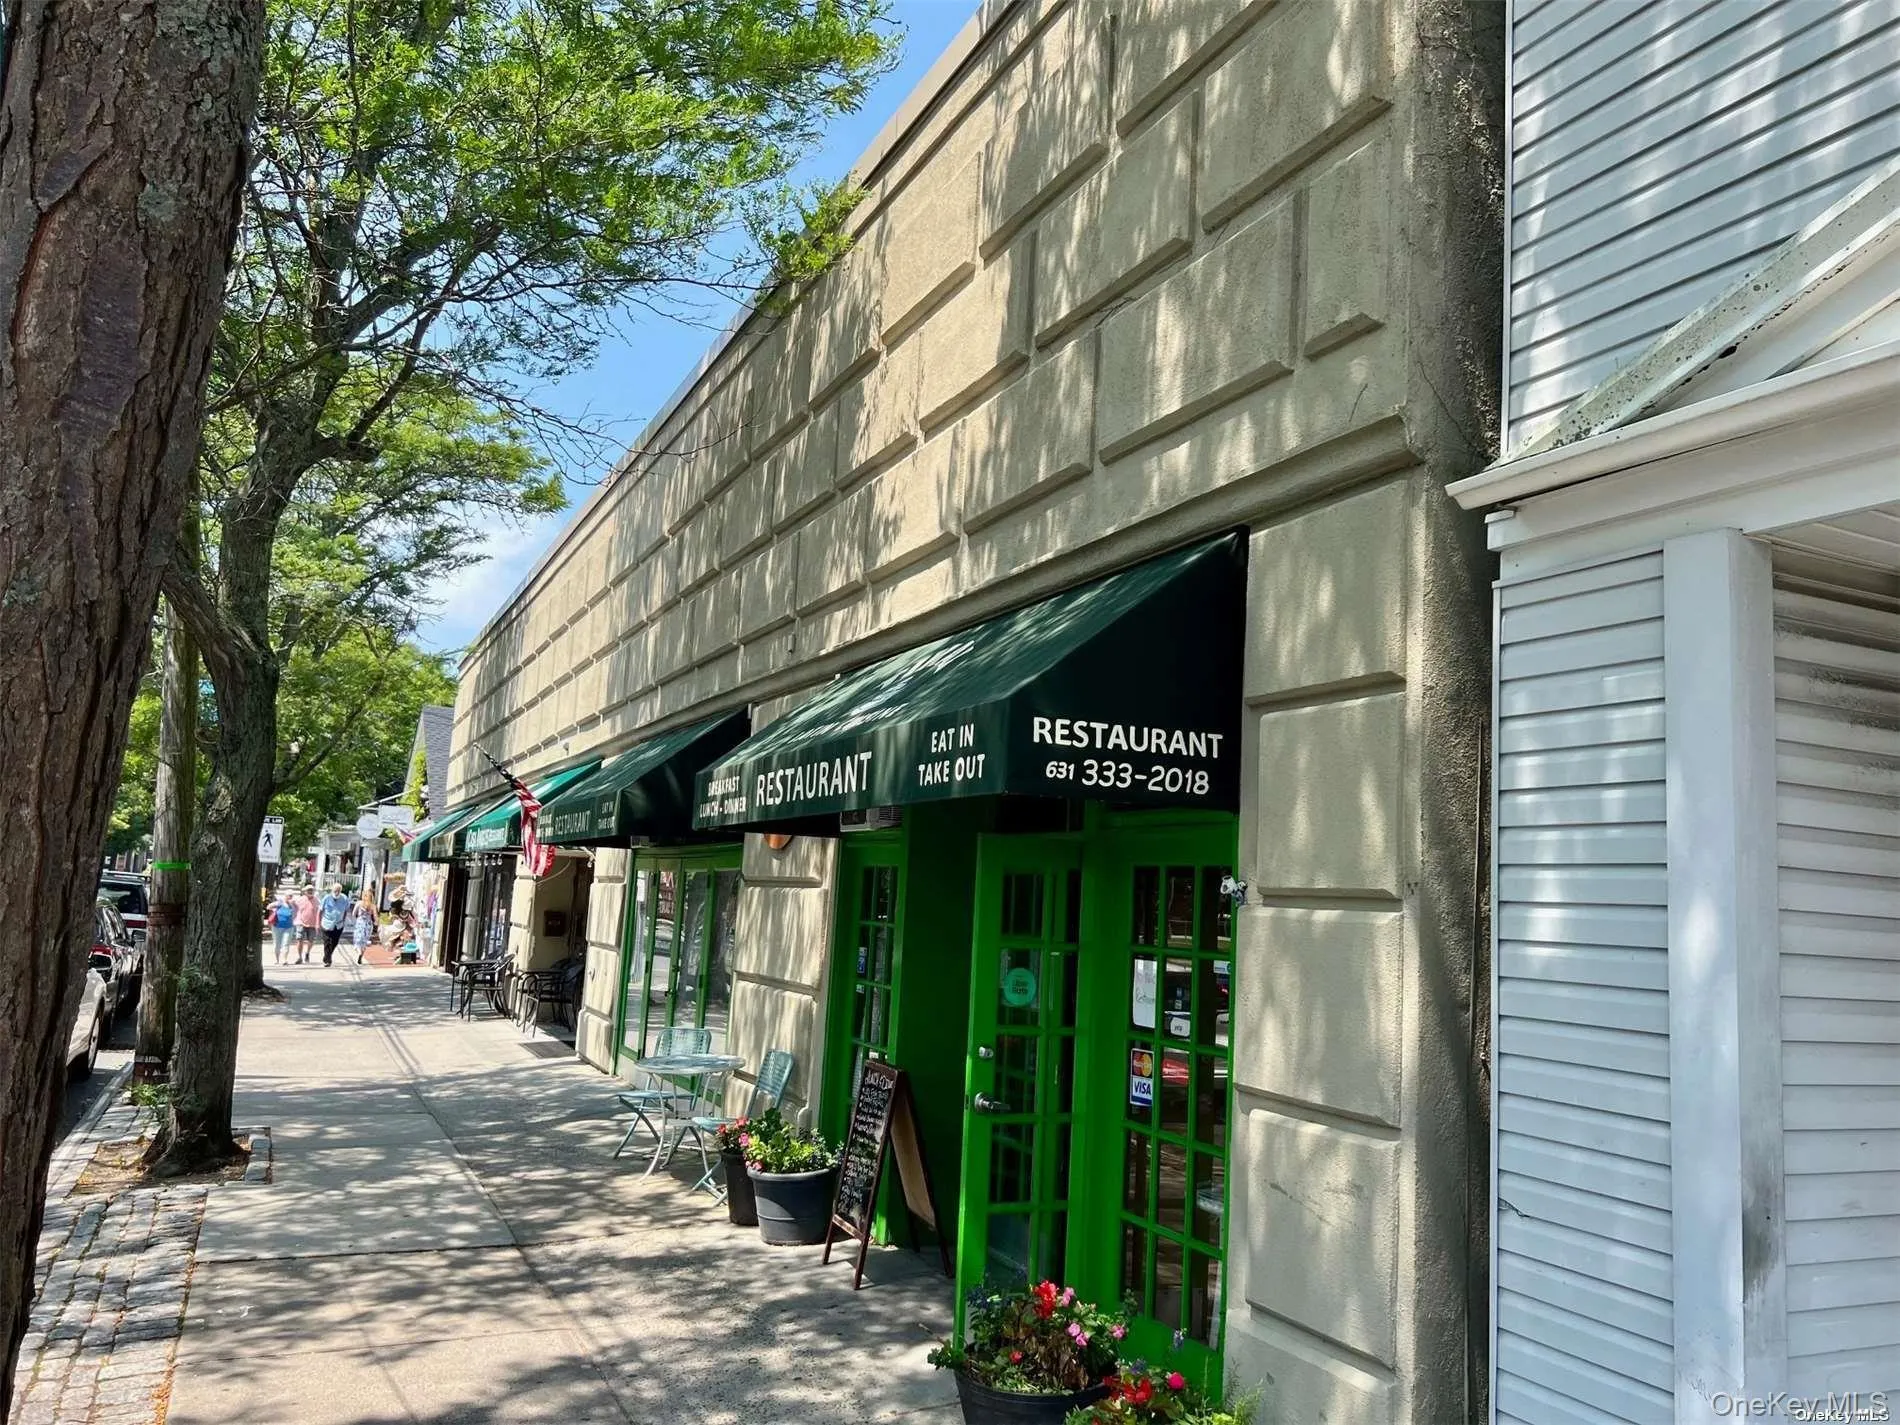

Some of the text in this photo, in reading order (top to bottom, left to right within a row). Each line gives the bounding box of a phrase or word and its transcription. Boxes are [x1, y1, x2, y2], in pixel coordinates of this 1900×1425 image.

[931, 723, 975, 753] EAT IN
[1033, 716, 1224, 759] RESTAURANT
[755, 751, 873, 807] RESTAURANT
[918, 754, 986, 786] TAKE OUT
[1045, 759, 1210, 795] 631 333-2018
[707, 775, 741, 797] BREAKFAST
[724, 796, 747, 815] DINNER
[555, 810, 591, 835] RESTAURANT
[1134, 1081, 1152, 1095] VISA
